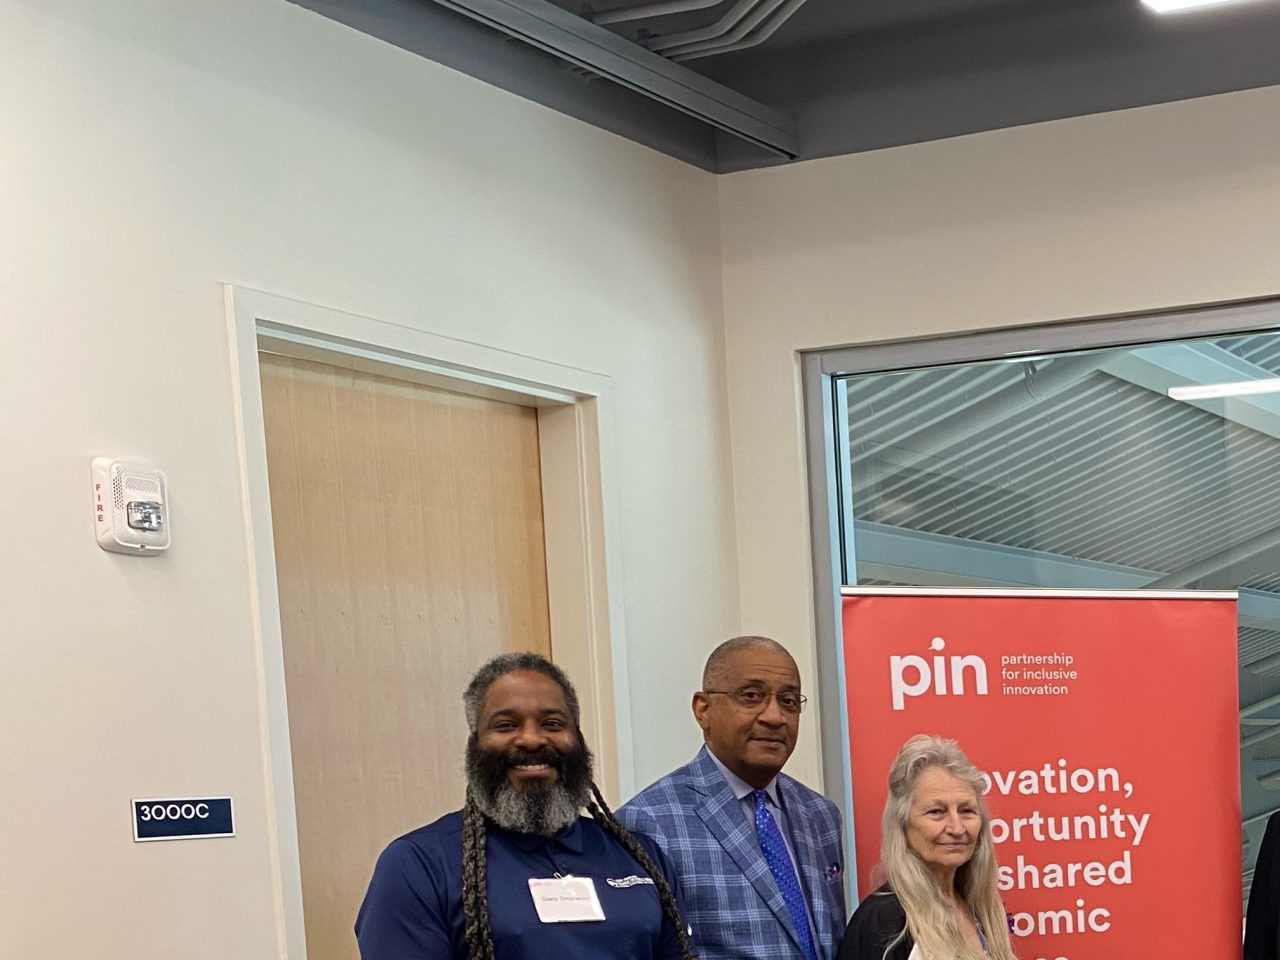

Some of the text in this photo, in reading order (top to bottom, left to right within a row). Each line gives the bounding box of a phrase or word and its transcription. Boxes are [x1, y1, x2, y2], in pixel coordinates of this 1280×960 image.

[96, 484, 104, 522] FIRE
[1001, 653, 1073, 666] partnership
[890, 637, 988, 710] pin
[1001, 668, 1077, 680] for inclusive
[1003, 684, 1068, 695] innovation
[997, 850, 1132, 891] shared
